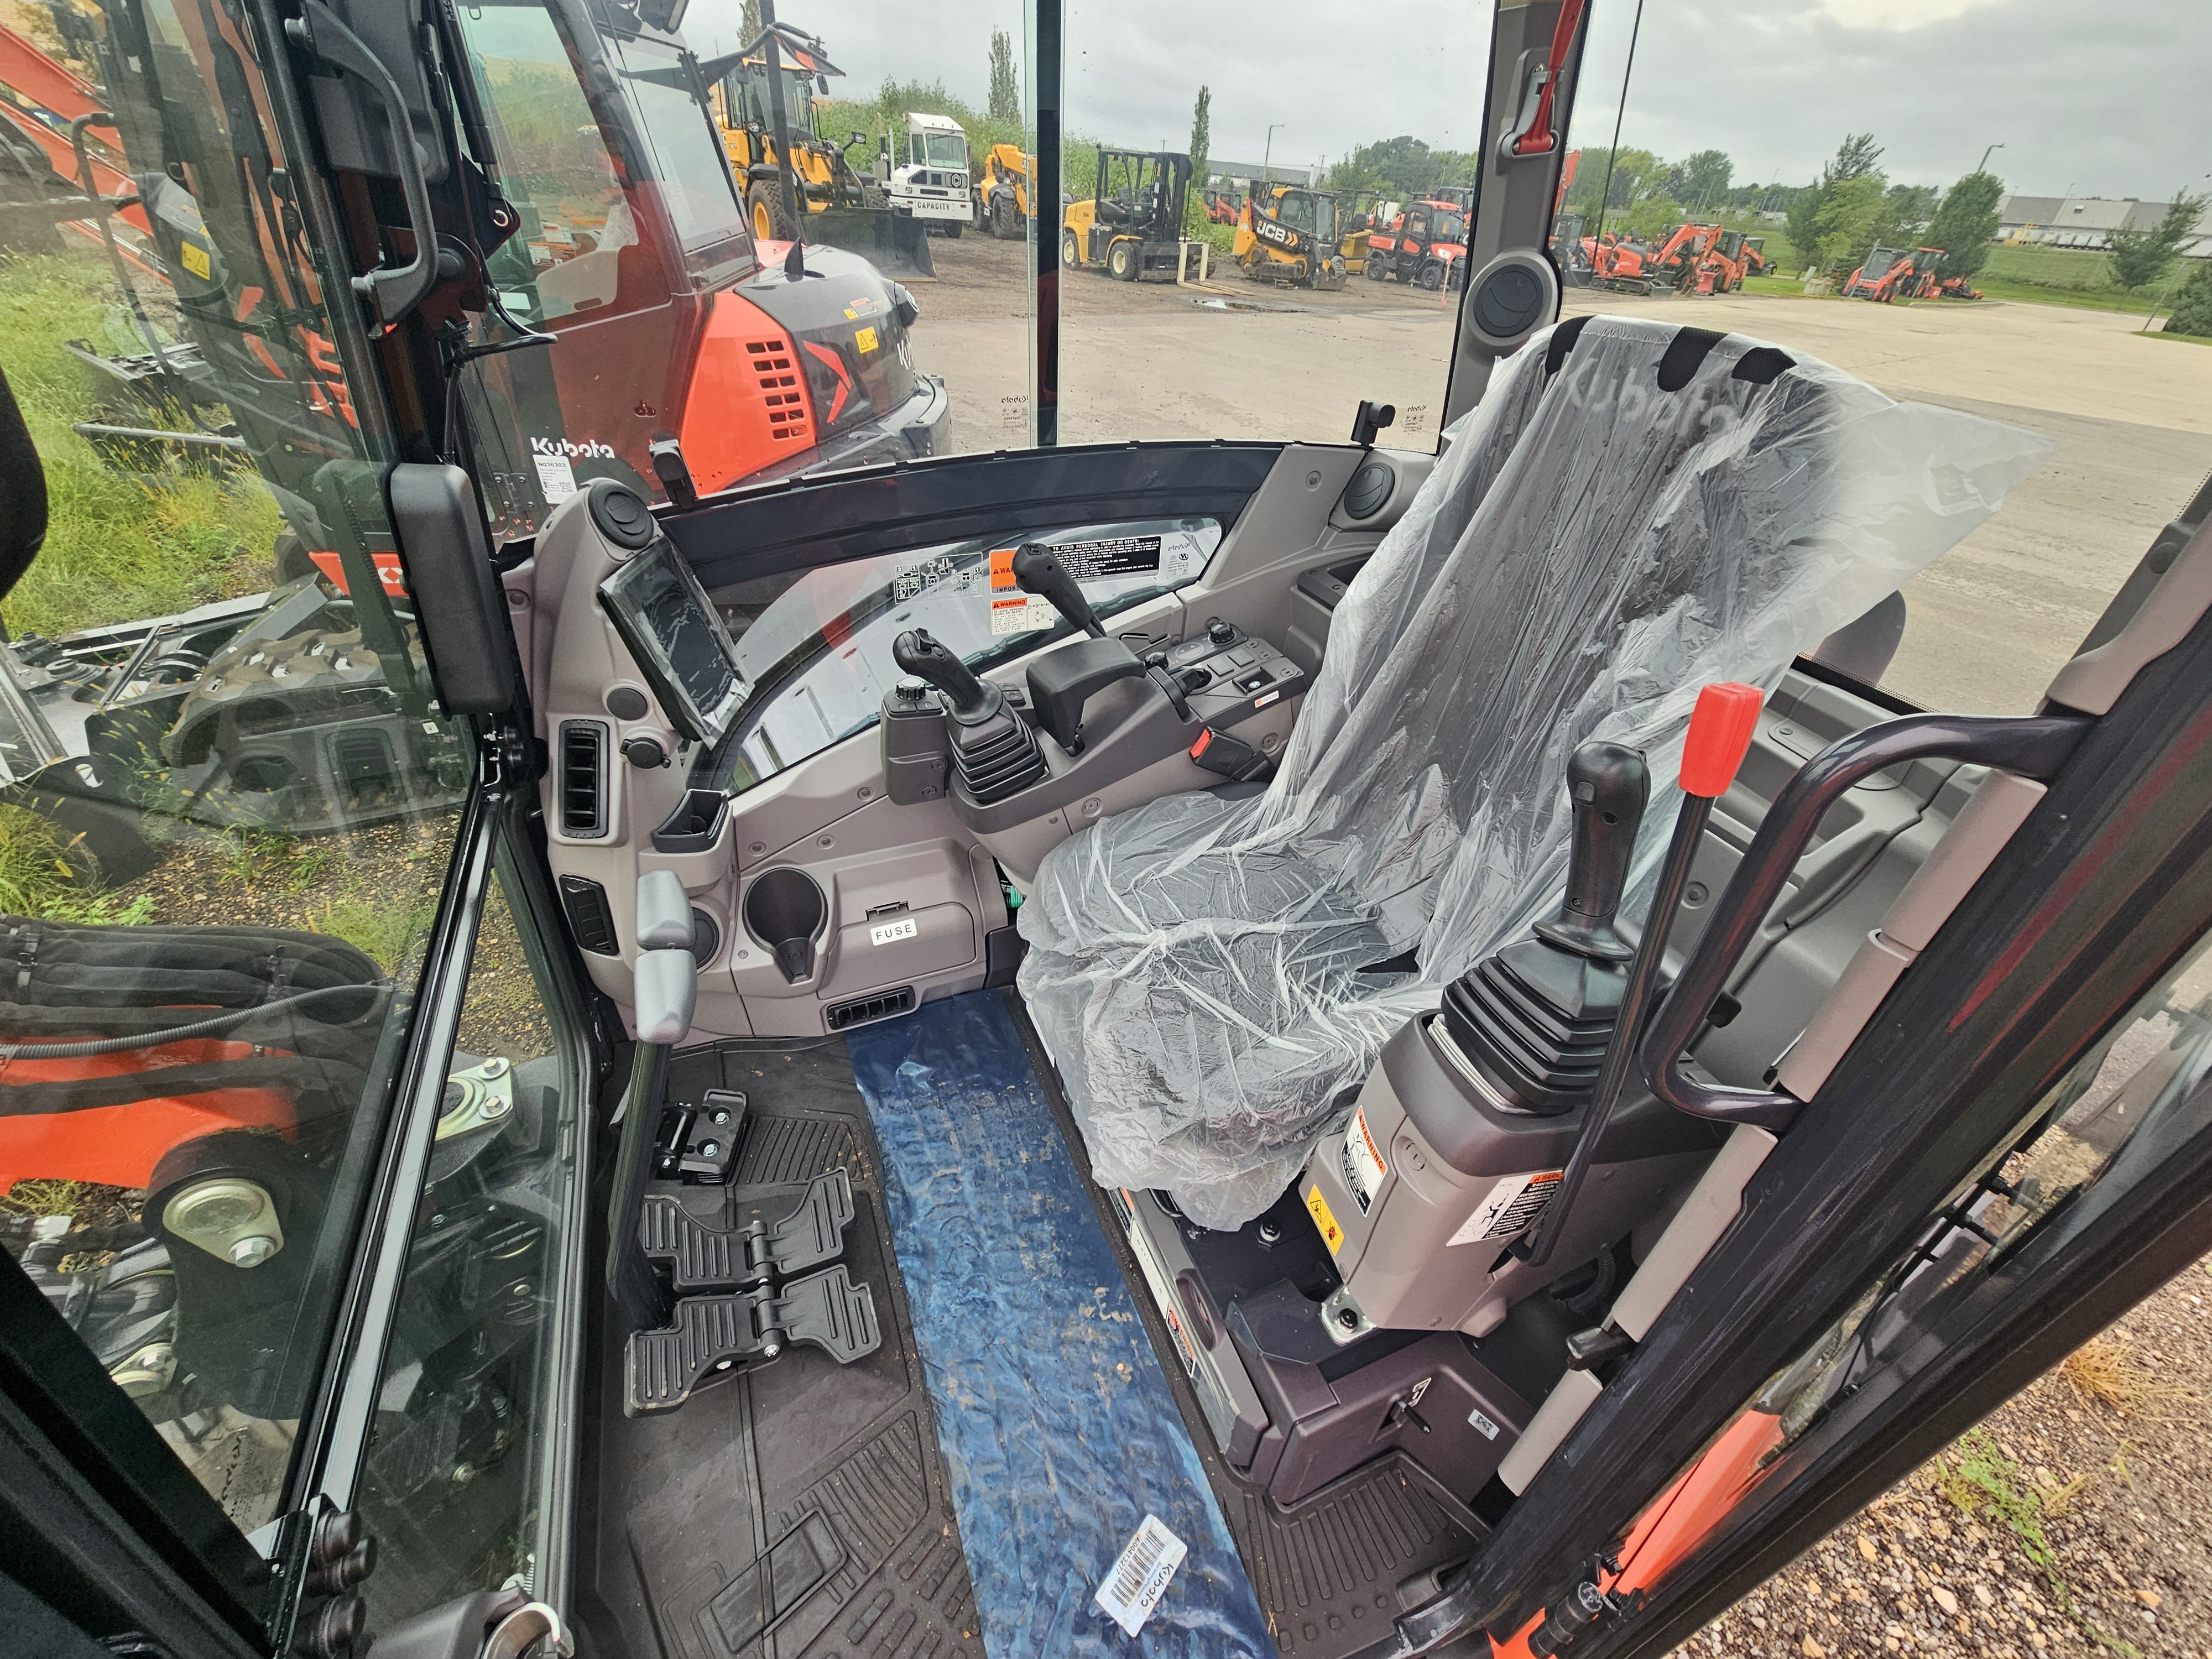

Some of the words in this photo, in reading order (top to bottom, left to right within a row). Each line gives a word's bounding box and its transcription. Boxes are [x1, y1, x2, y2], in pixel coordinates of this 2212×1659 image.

[917, 201, 950, 210] CAPACITY
[1256, 222, 1286, 242] JCB
[530, 437, 615, 458] Kubota
[876, 924, 912, 940] FUSE
[1360, 1120, 1384, 1170] WARNING
[1141, 1563, 1174, 1607] Kubota
